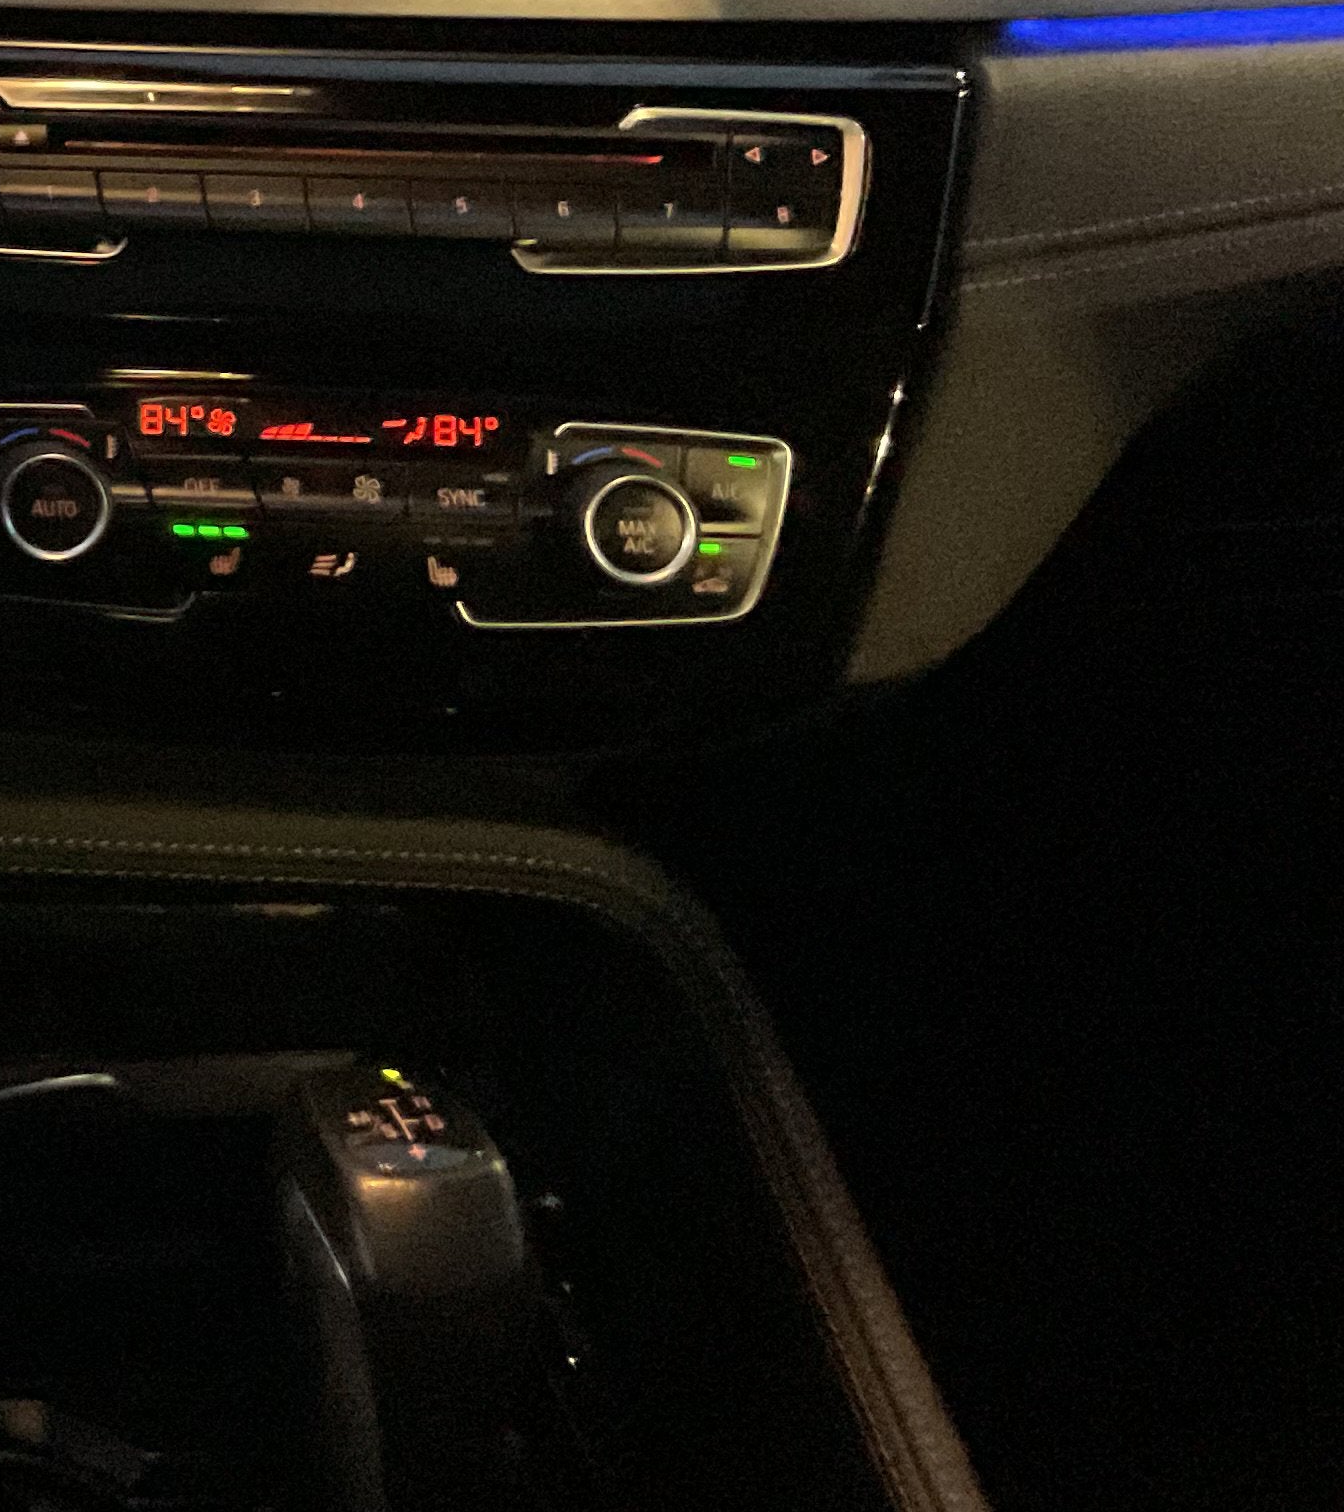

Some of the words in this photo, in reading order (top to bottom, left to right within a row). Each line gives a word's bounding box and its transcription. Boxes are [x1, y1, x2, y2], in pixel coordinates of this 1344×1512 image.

[557, 200, 571, 218] 6
[664, 202, 675, 219] 7
[139, 403, 206, 437] 84°
[433, 414, 499, 448] 84°
[436, 486, 487, 509] SYNC
[31, 499, 80, 519] AUTO
